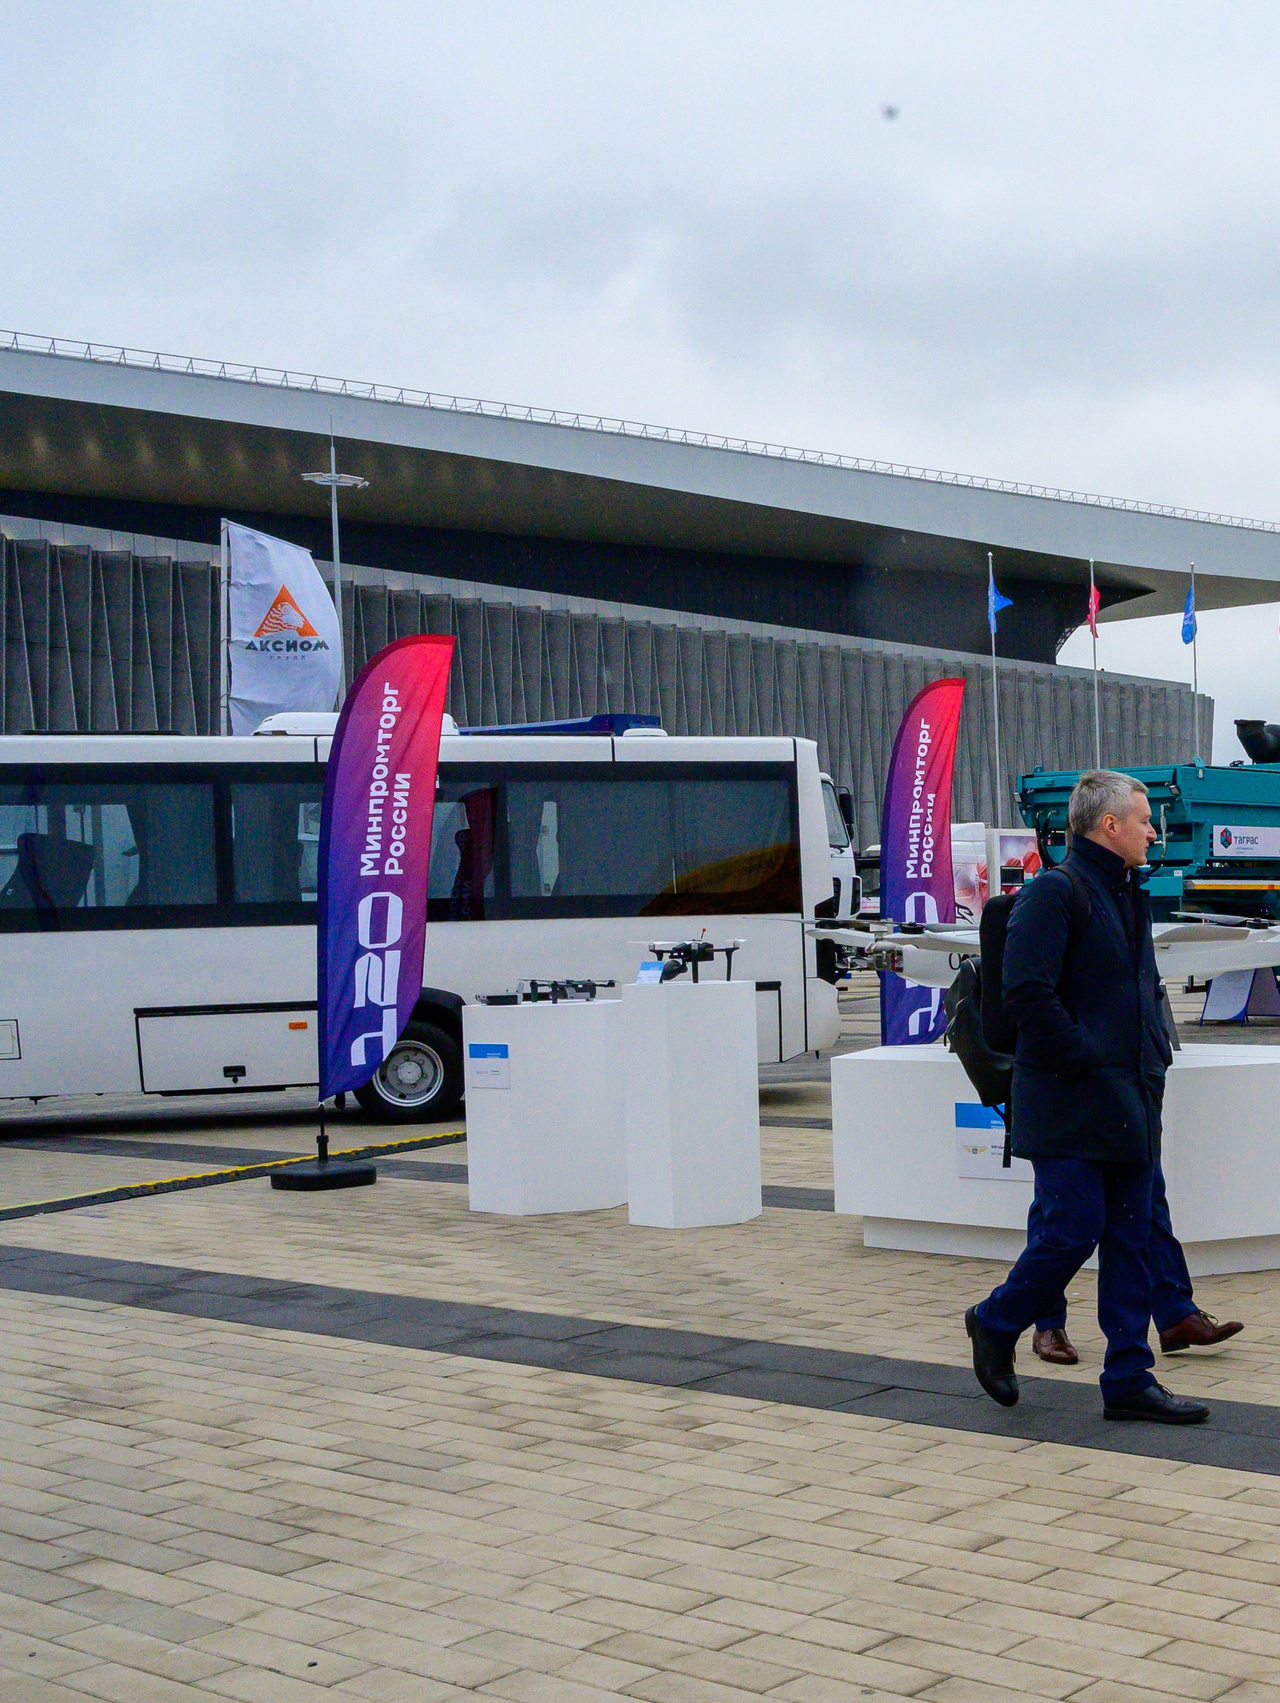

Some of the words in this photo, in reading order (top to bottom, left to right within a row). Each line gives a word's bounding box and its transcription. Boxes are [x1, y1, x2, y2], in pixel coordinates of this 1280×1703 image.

[245, 640, 330, 652] АКСИОМ
[360, 682, 402, 876] Минпромторг
[384, 773, 411, 875] России
[906, 718, 932, 879] Минпромторг
[920, 793, 936, 878] России
[350, 891, 403, 1066] 120
